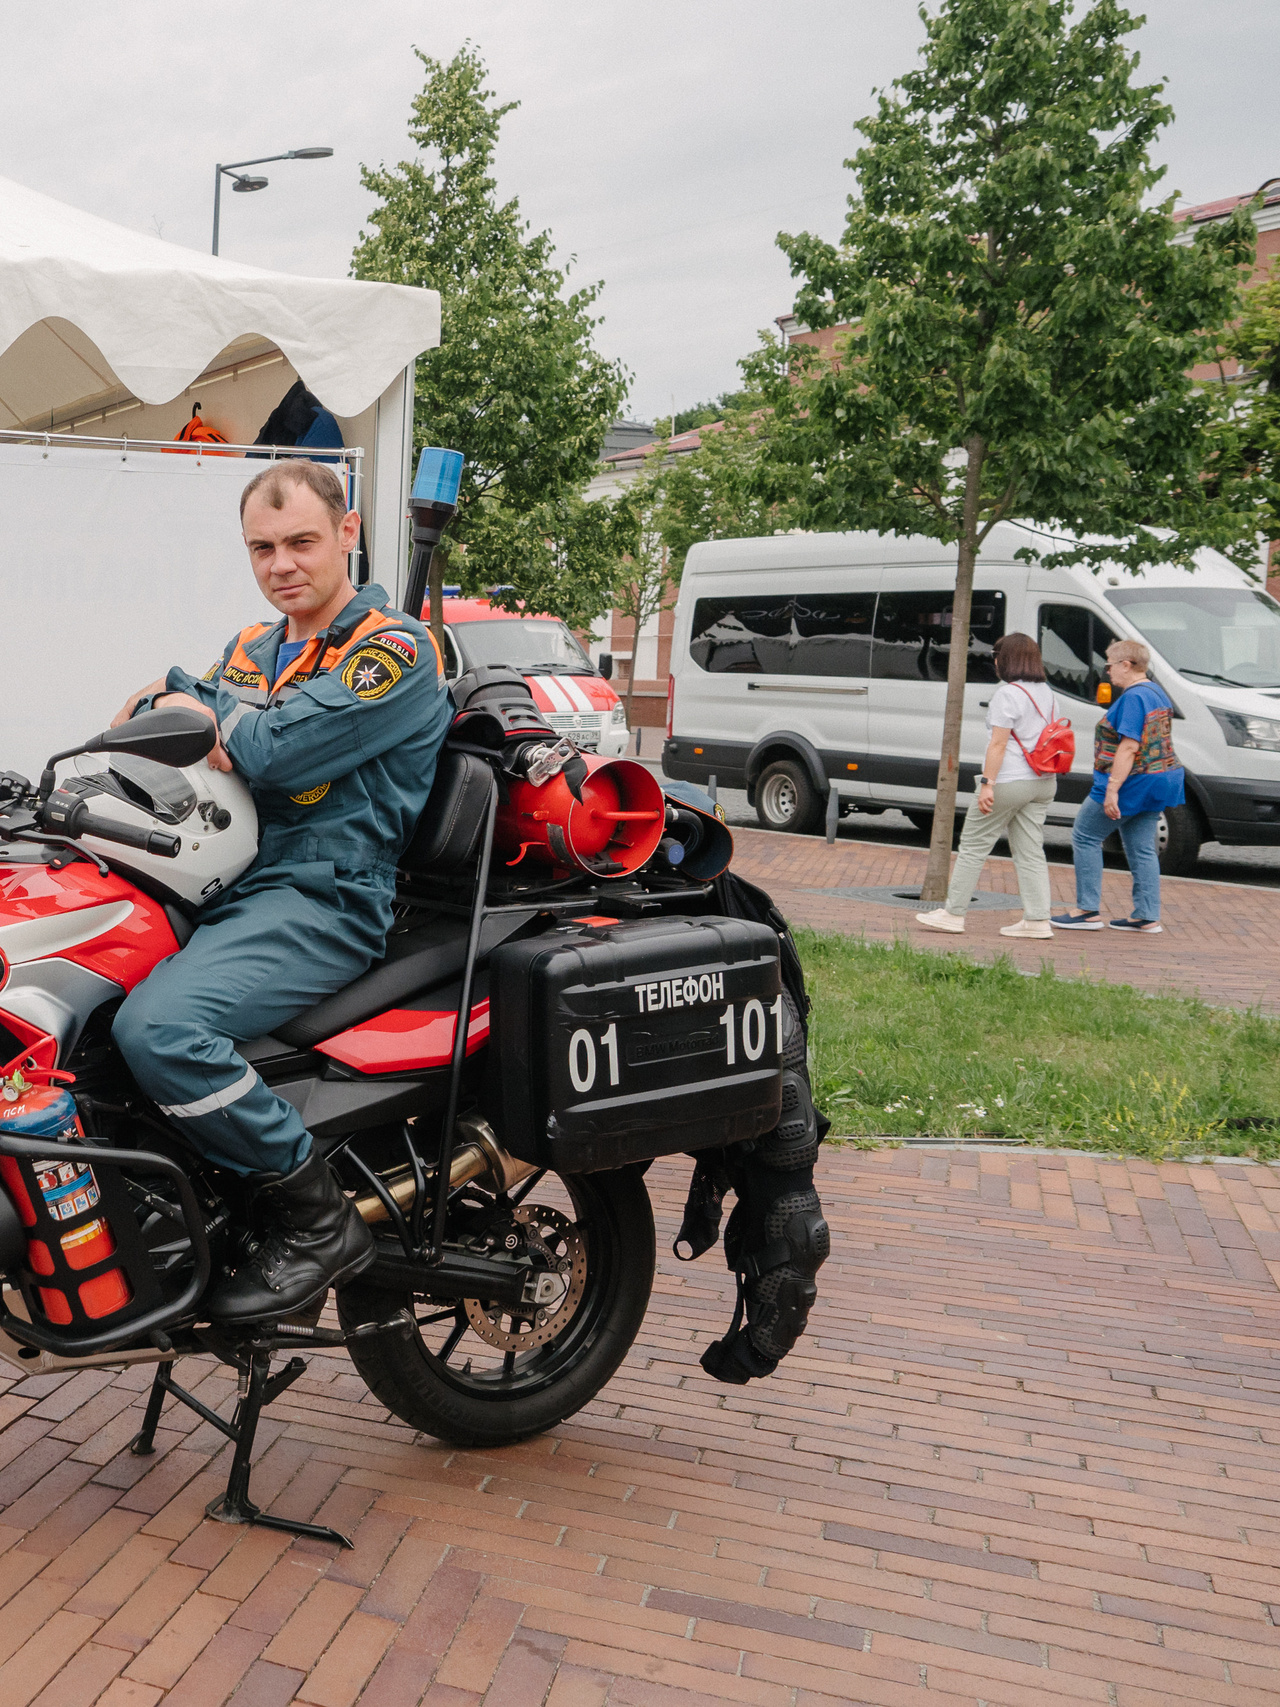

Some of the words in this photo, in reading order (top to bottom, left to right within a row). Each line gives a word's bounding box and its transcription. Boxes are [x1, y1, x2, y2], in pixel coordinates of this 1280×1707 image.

[380, 637, 409, 657] RUSSIA
[224, 667, 242, 682] МЧС
[634, 972, 725, 1013] ТЕЛЕФОН
[568, 1023, 620, 1093] 01
[719, 994, 783, 1066] 101
